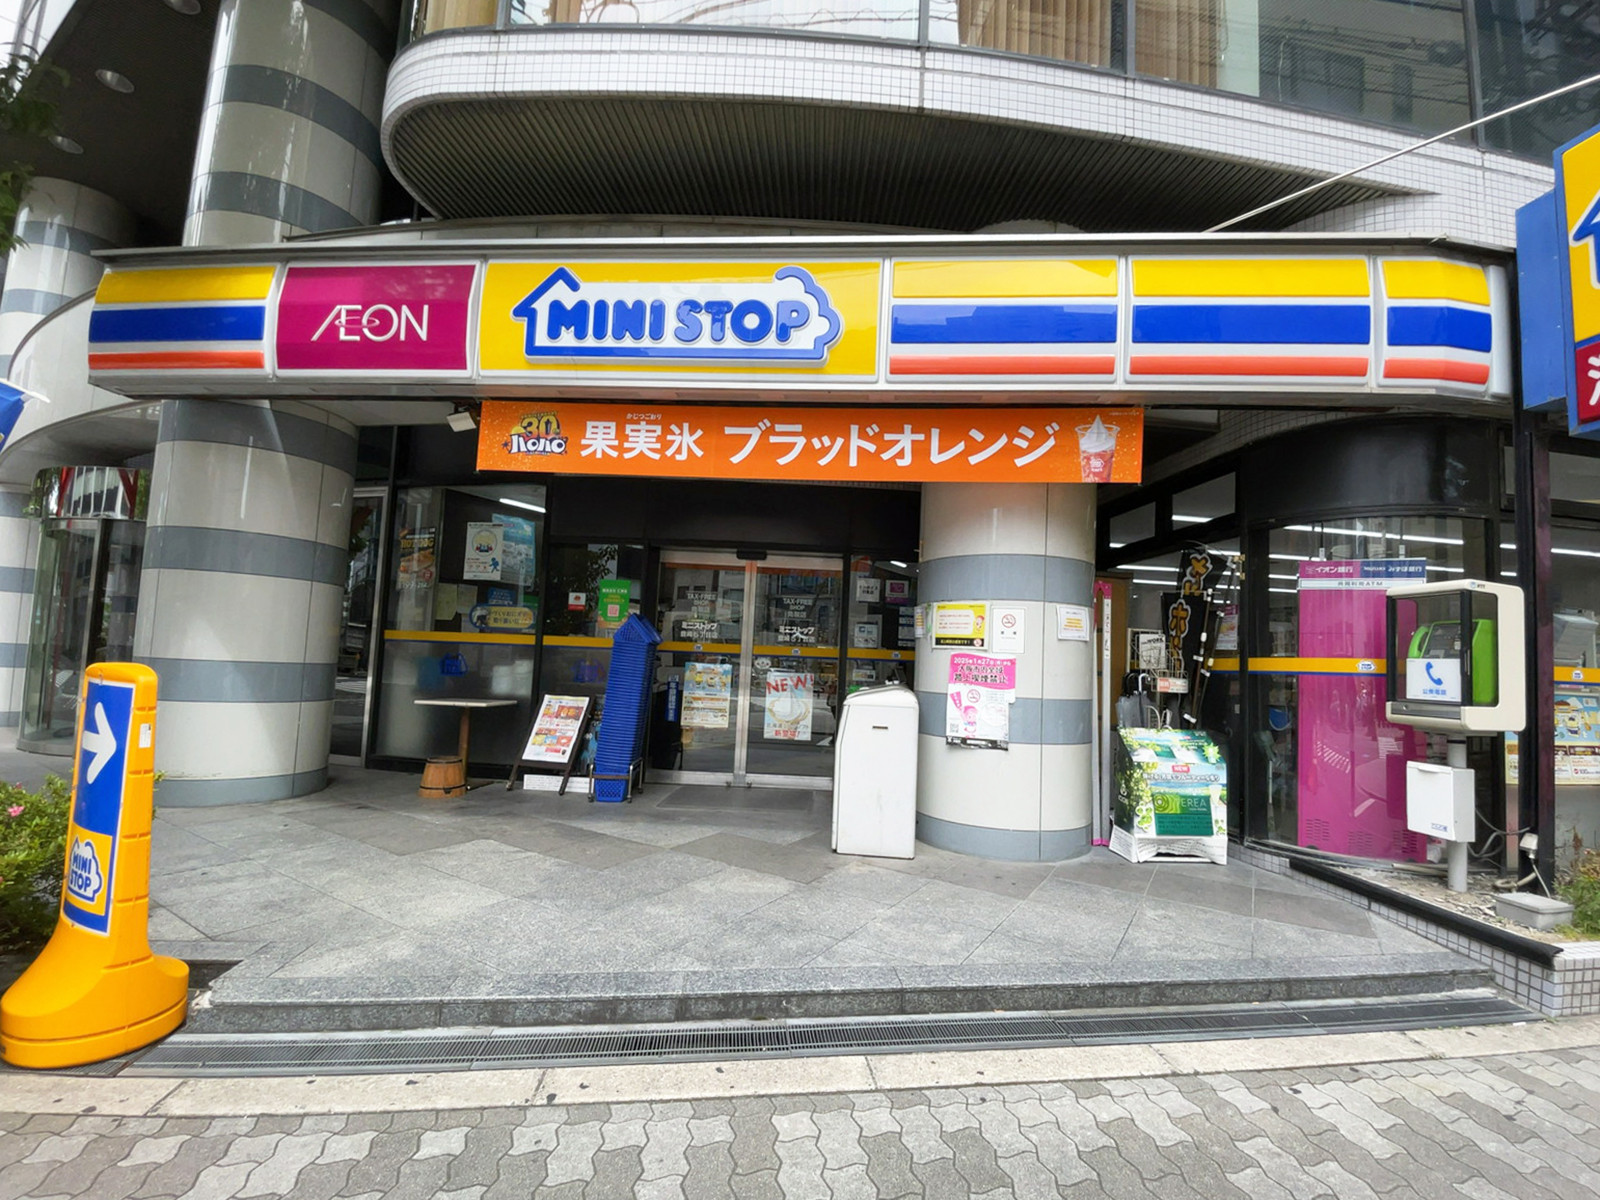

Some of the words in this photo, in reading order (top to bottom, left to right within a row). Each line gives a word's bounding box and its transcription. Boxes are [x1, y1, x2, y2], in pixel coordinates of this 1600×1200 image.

[626, 412, 662, 420] かじつごおり
[521, 415, 561, 438] 30
[580, 421, 704, 461] 果実氷
[724, 418, 1060, 468] ブラッドオレンジ
[681, 621, 717, 631] ミニストップ
[779, 625, 815, 635] ミニストップ
[766, 674, 815, 694] NEW!
[954, 673, 1009, 684] 路上喫煙禁止
[73, 851, 92, 875] MINI
[70, 868, 92, 892] STOP
